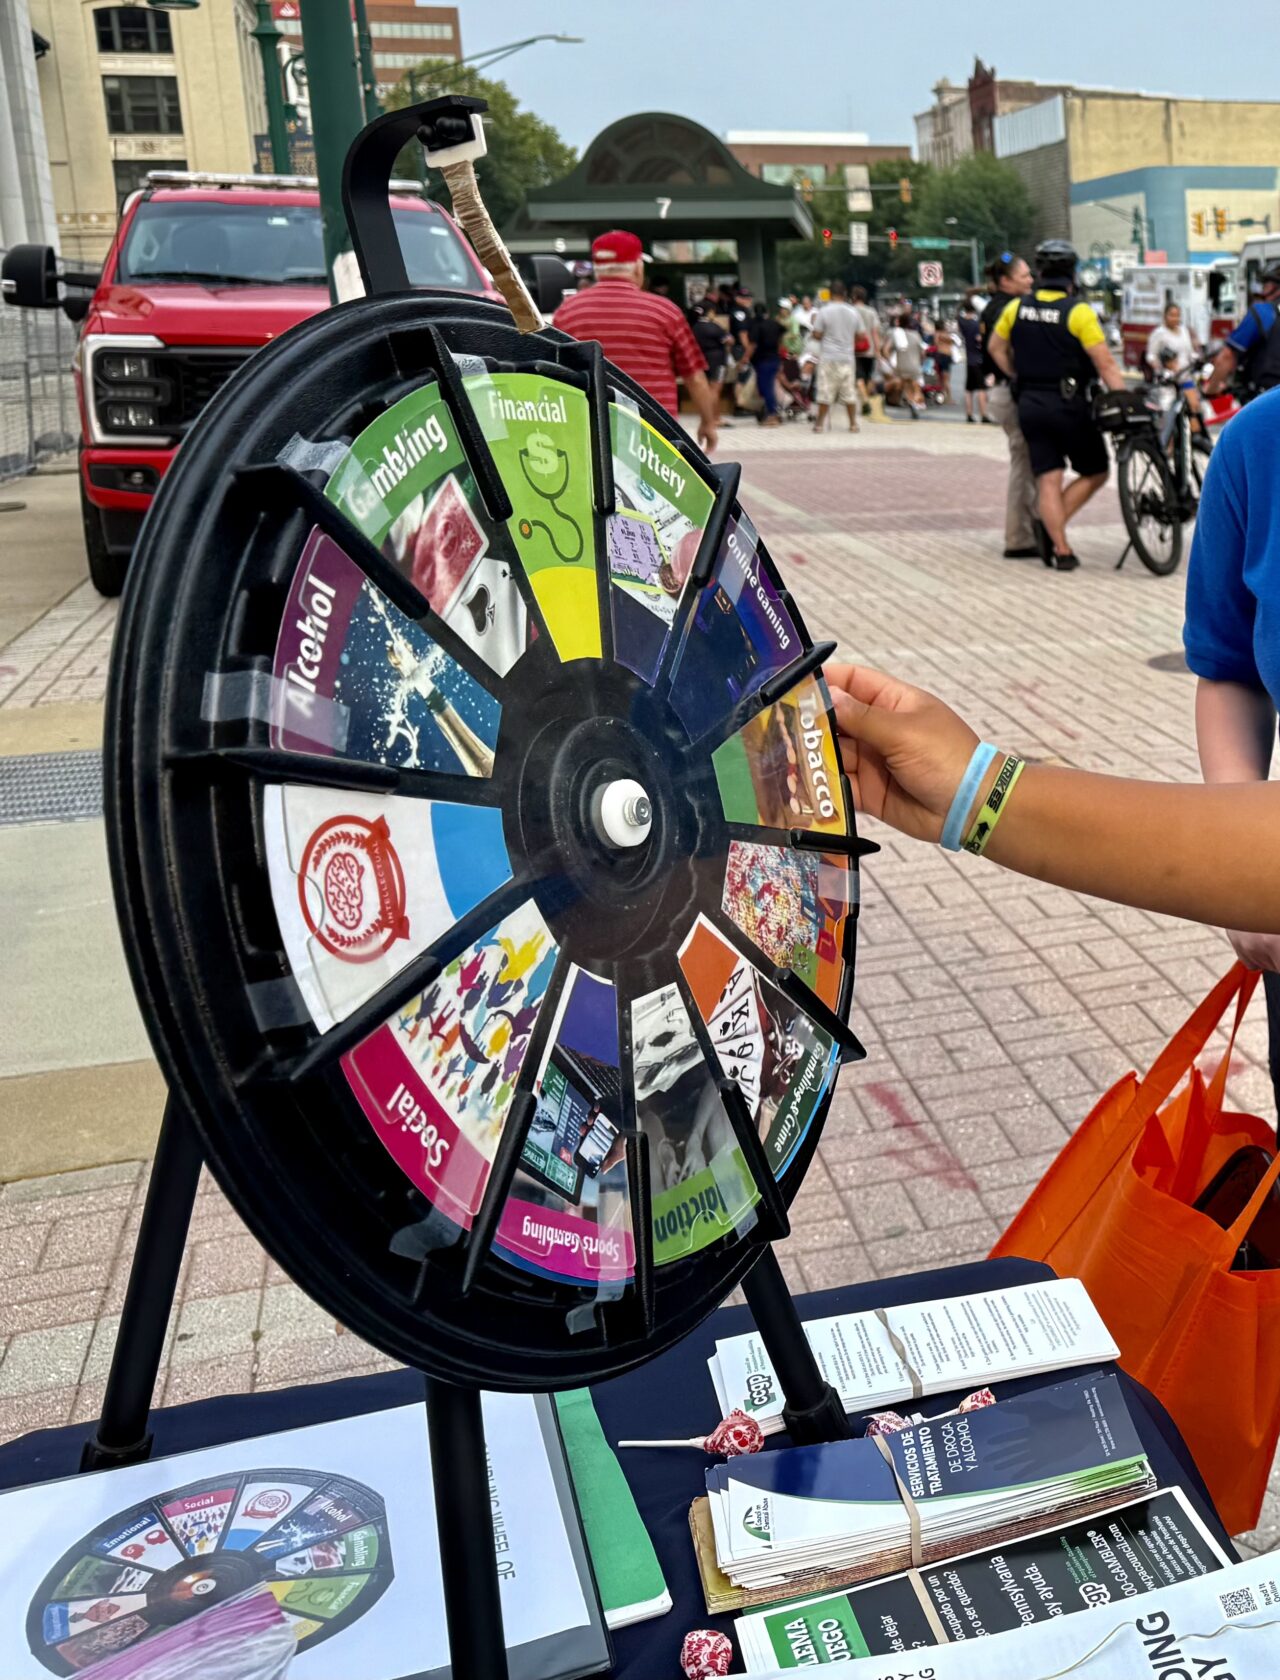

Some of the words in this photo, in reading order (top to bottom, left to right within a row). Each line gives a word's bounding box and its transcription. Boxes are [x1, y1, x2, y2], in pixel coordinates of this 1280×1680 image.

[656, 197, 672, 219] 7
[488, 389, 569, 424] Financial
[347, 413, 450, 519] Gambling
[628, 431, 687, 499] Lottery
[727, 532, 758, 589] Online
[756, 585, 791, 651] Gaming
[287, 574, 336, 718] Alcohol
[797, 692, 836, 819] Tobacco
[793, 1040, 825, 1105] Gambling
[385, 1082, 451, 1168] Social
[774, 1110, 796, 1154] Crime
[655, 1182, 733, 1244] diction
[583, 1232, 620, 1263] Sports
[747, 1374, 772, 1405] ccgp
[901, 1430, 915, 1447] DE
[941, 1421, 960, 1458] DROGA
[956, 1417, 977, 1462] ALCOHOL
[904, 1446, 925, 1498] SERVICIOS
[918, 1426, 944, 1495] TRATAMIENTO
[948, 1458, 963, 1473] DE
[184, 1495, 214, 1511] Social
[103, 1516, 152, 1550] Emotional
[927, 1574, 941, 1588] un
[932, 1587, 951, 1604] por
[943, 1569, 973, 1607] querido?
[1023, 1562, 1054, 1601] ayuda.
[880, 1615, 900, 1638] dejar
[940, 1602, 967, 1641] ocupado
[964, 1606, 979, 1621] ser
[1045, 1601, 1064, 1616] ay
